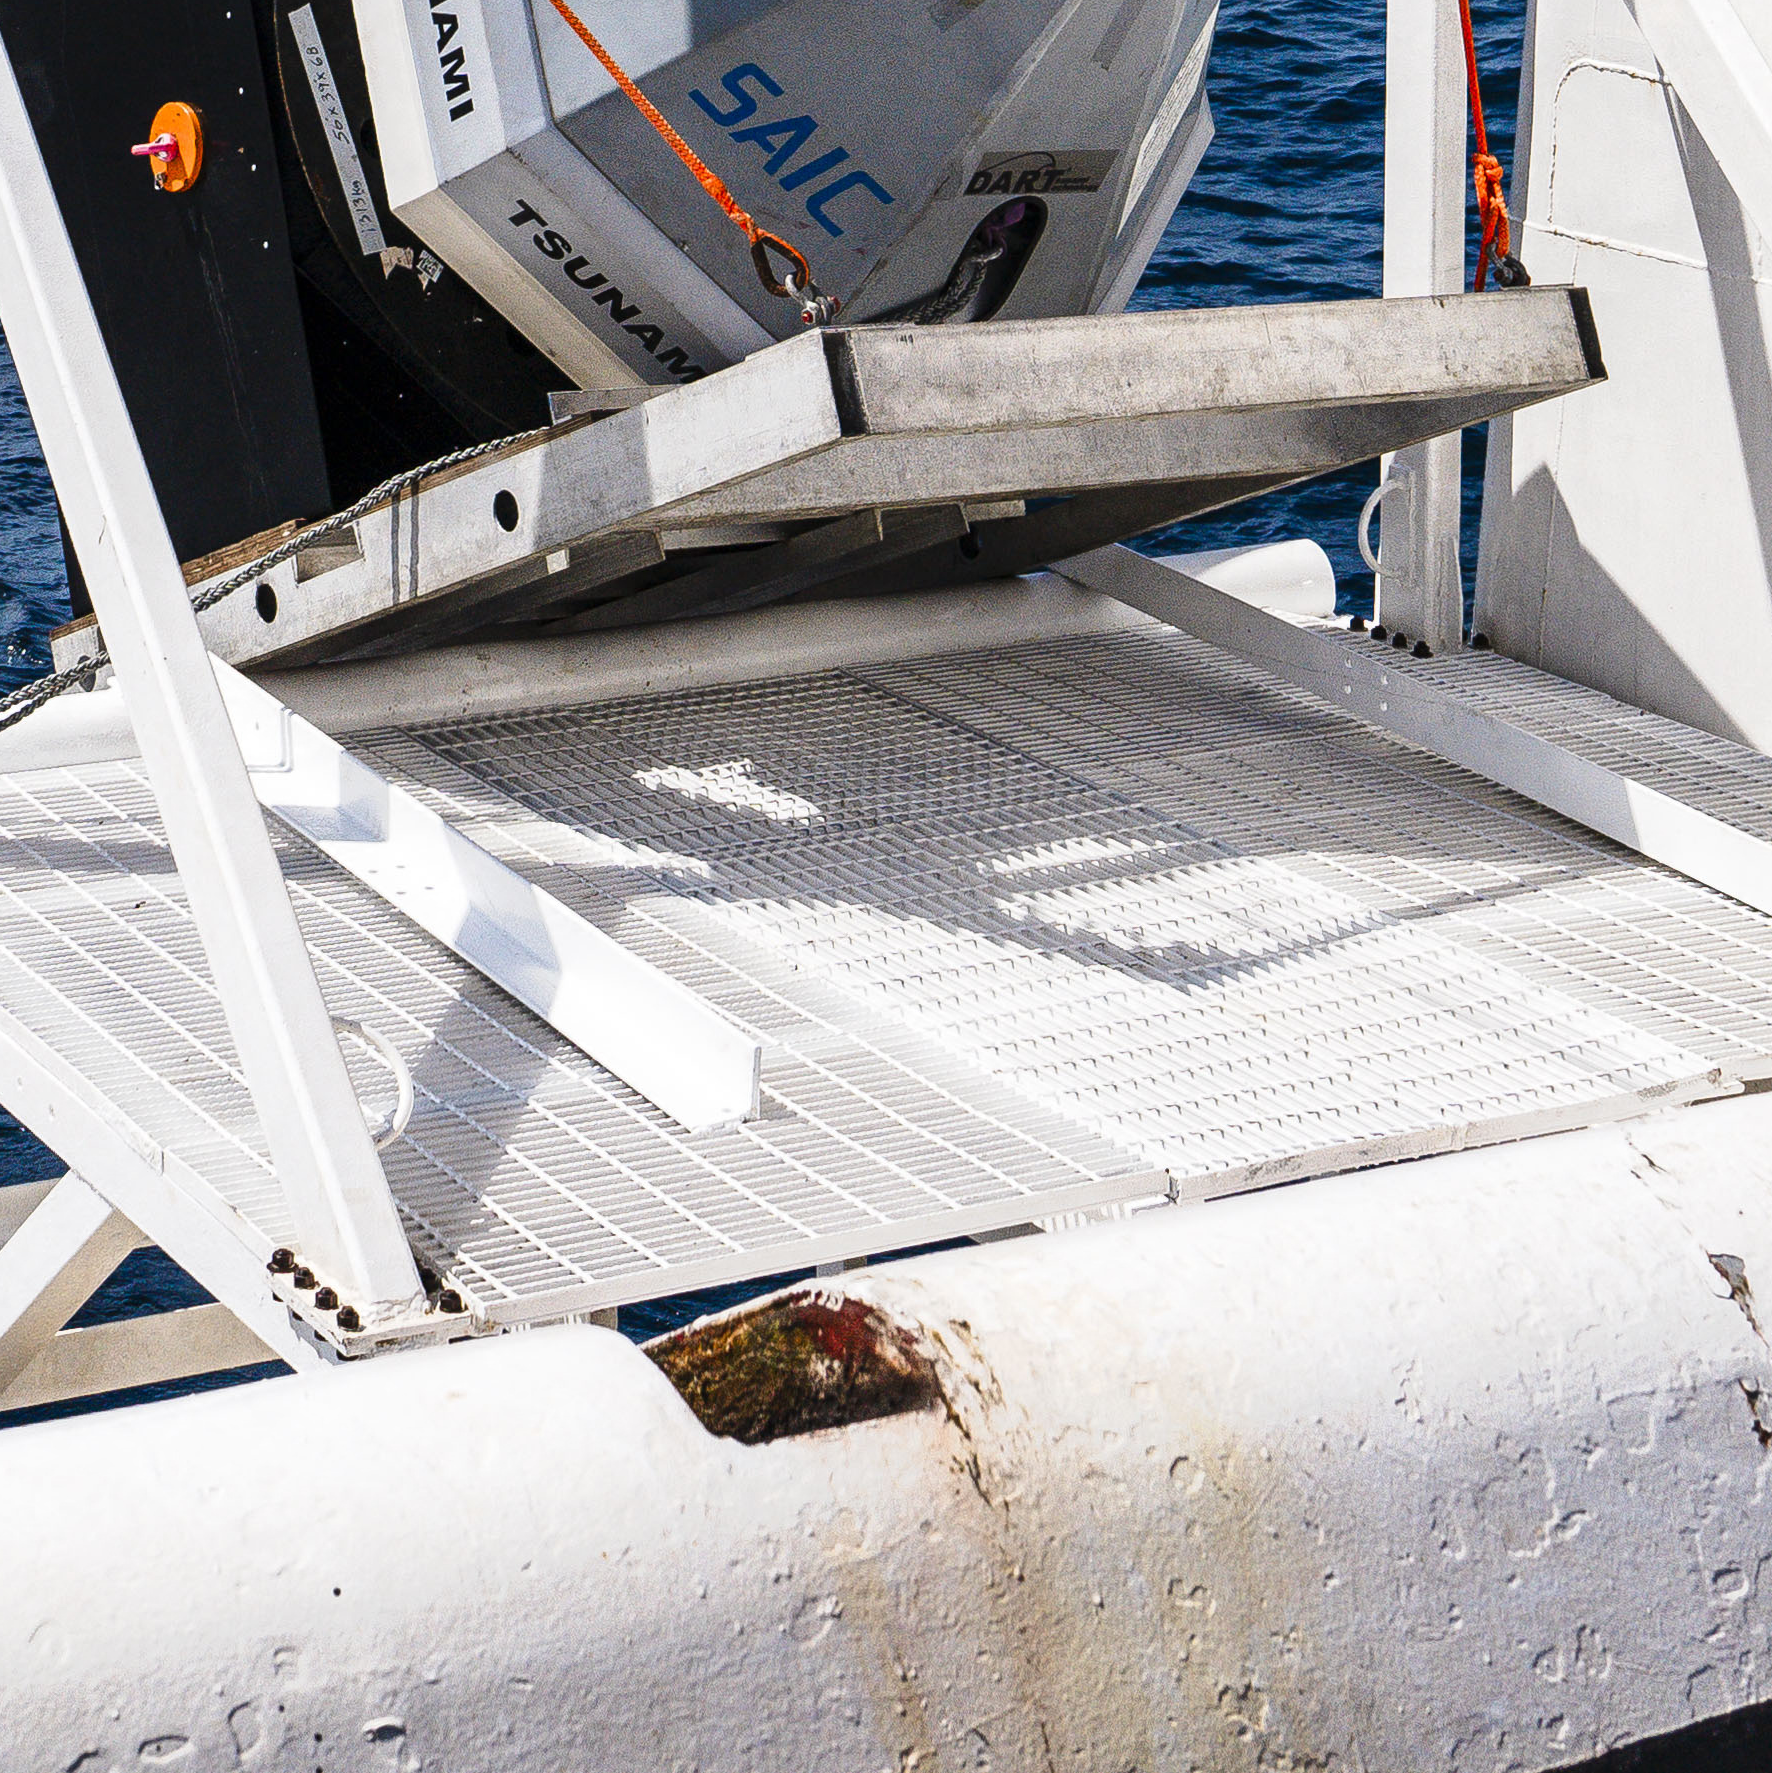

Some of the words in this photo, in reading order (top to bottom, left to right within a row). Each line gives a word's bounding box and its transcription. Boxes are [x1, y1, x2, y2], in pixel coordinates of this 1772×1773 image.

[688, 63, 895, 237] SAIC
[963, 168, 1071, 196] DART
[508, 199, 709, 384] TSUNAM
